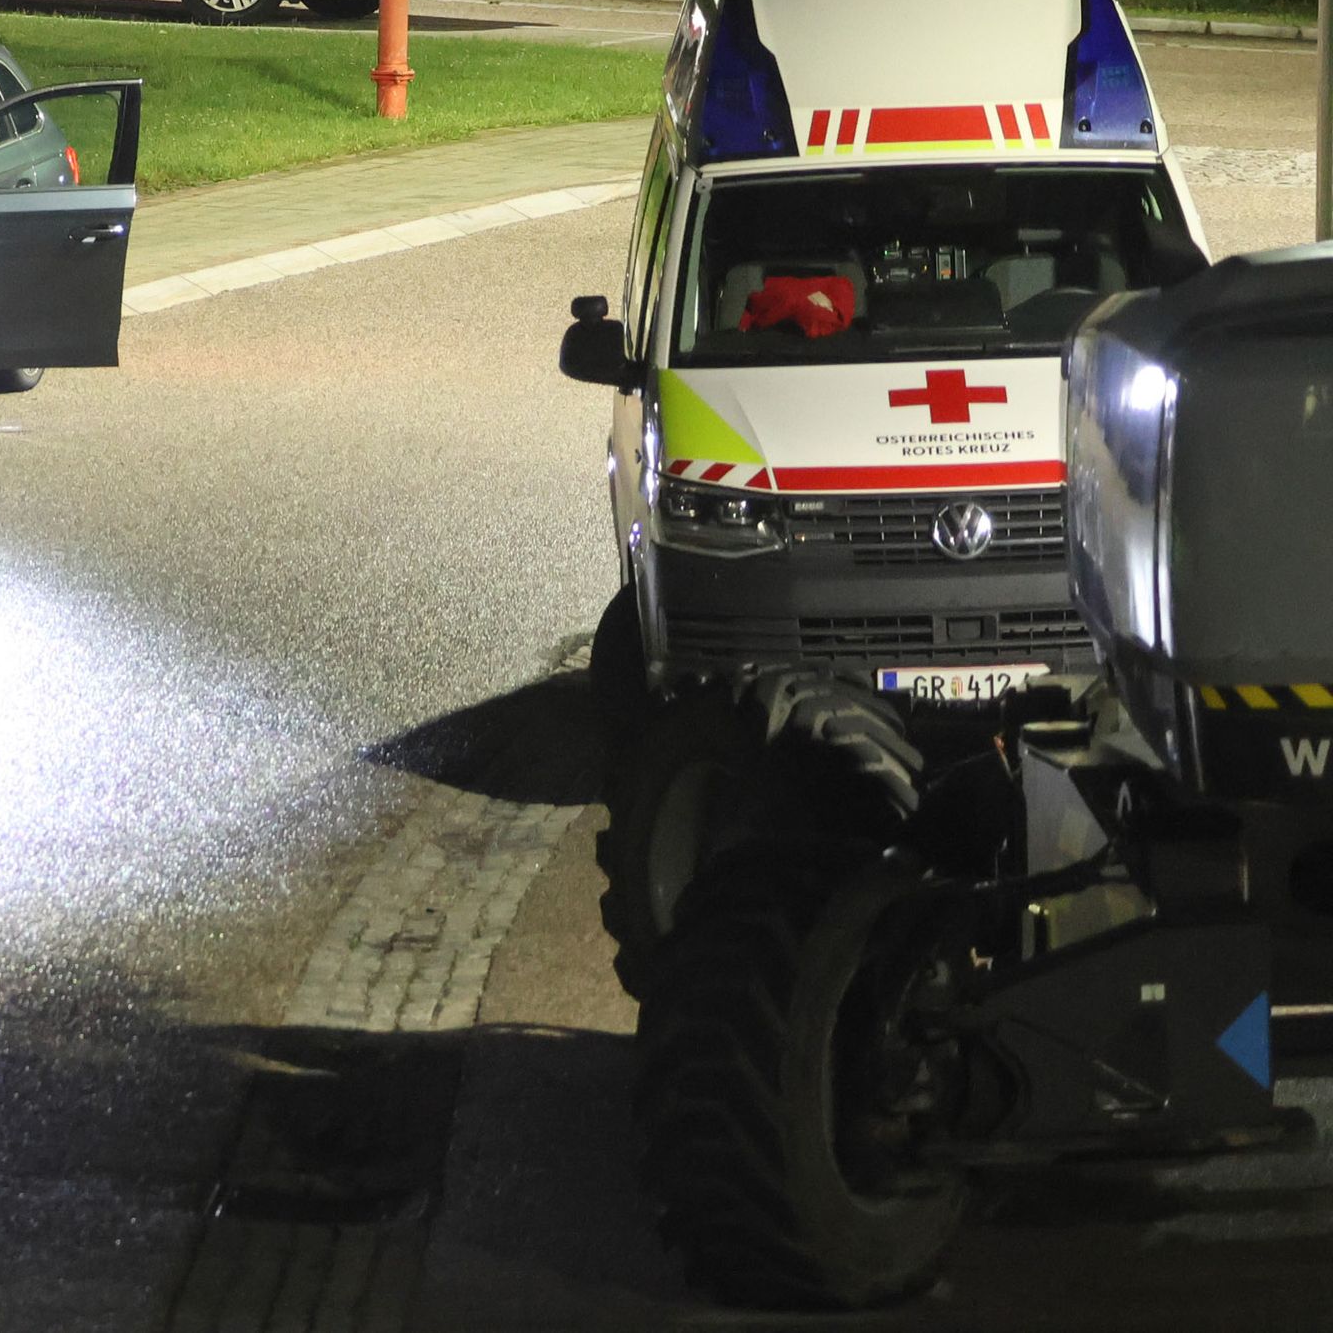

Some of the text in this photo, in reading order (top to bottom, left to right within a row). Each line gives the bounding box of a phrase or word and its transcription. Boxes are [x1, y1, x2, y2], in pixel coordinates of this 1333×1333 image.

[876, 430, 1035, 444] ÖSTERREICHISCHES
[902, 443, 1011, 456] ROTES KREUZ
[913, 675, 946, 700] GR
[1280, 738, 1331, 777] W
